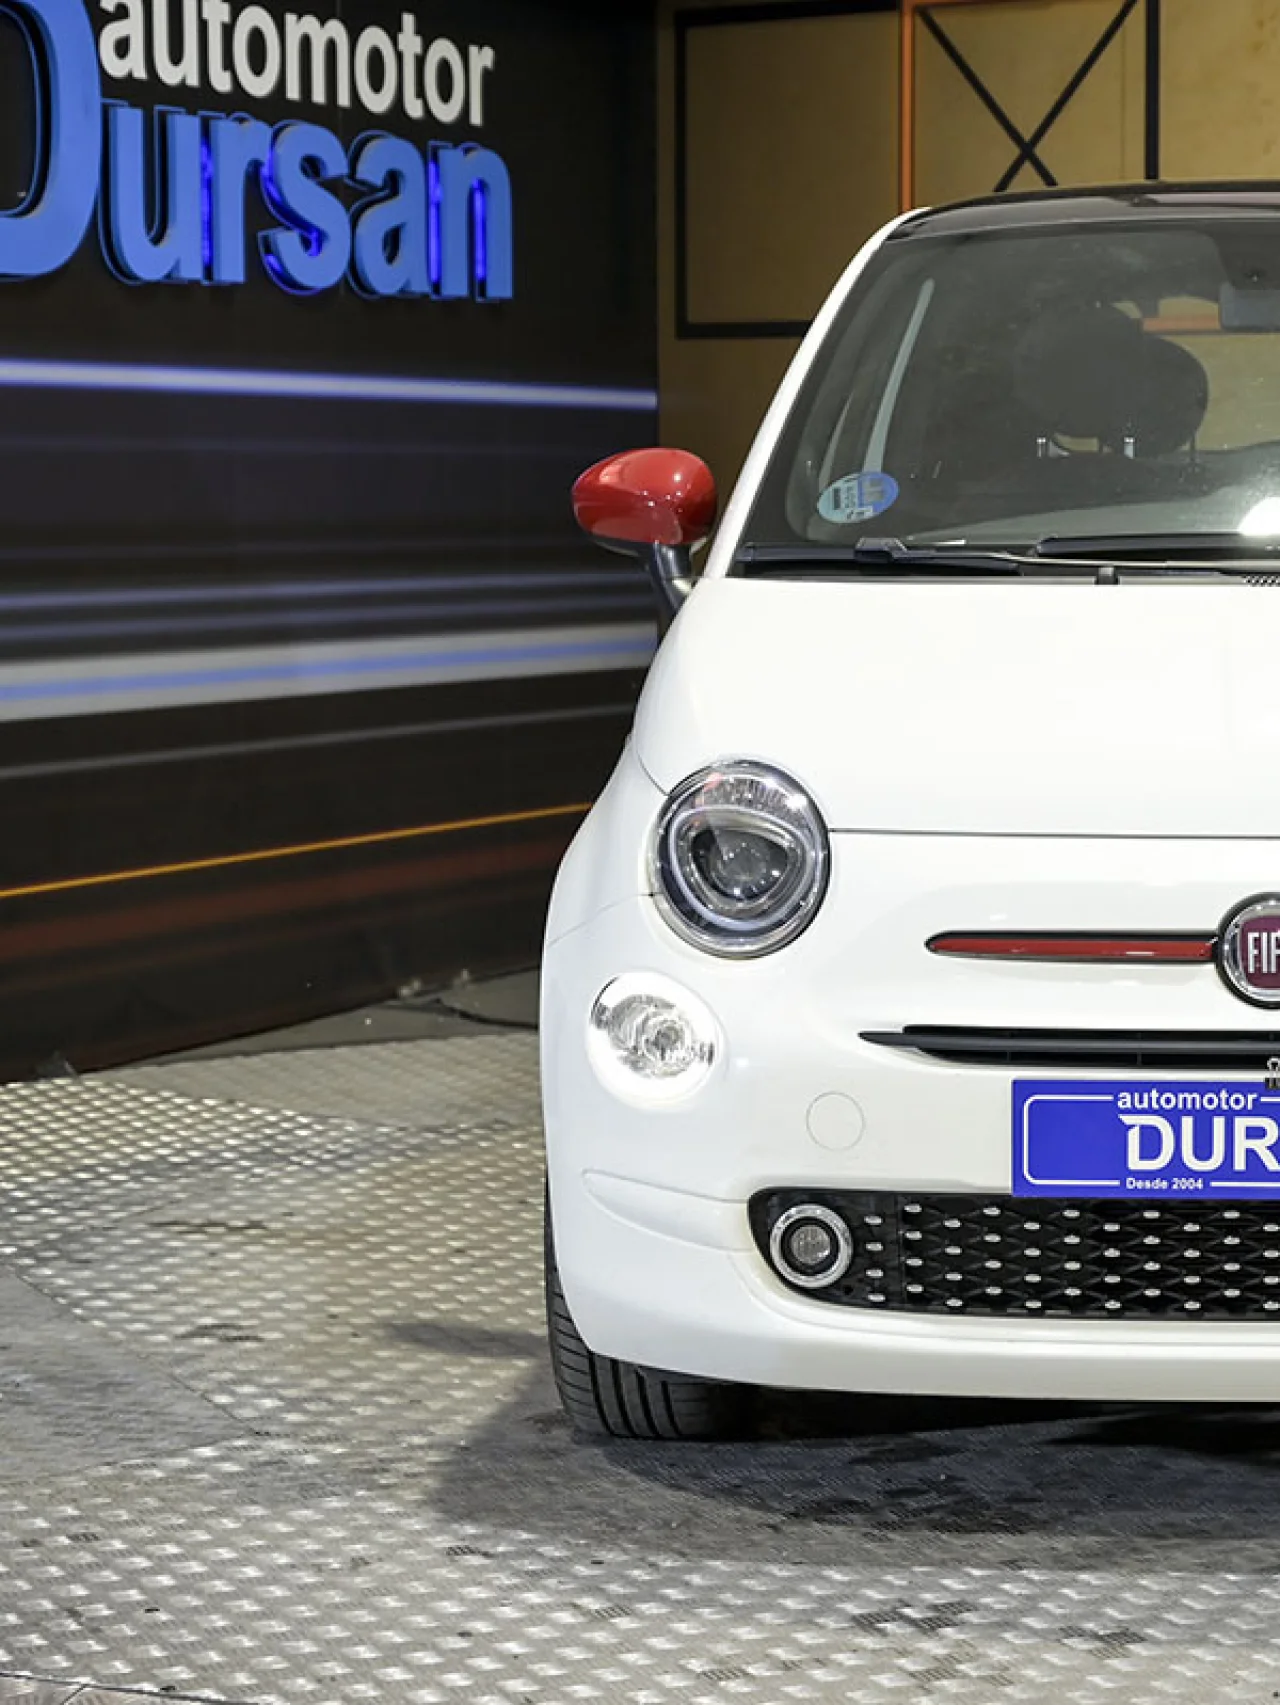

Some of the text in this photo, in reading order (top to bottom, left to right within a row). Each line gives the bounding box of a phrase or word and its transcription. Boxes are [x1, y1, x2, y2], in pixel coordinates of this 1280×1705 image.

[100, 0, 495, 126] automotor
[1117, 1087, 1258, 1111] automotor
[1125, 1176, 1205, 1190] Desde 2004
